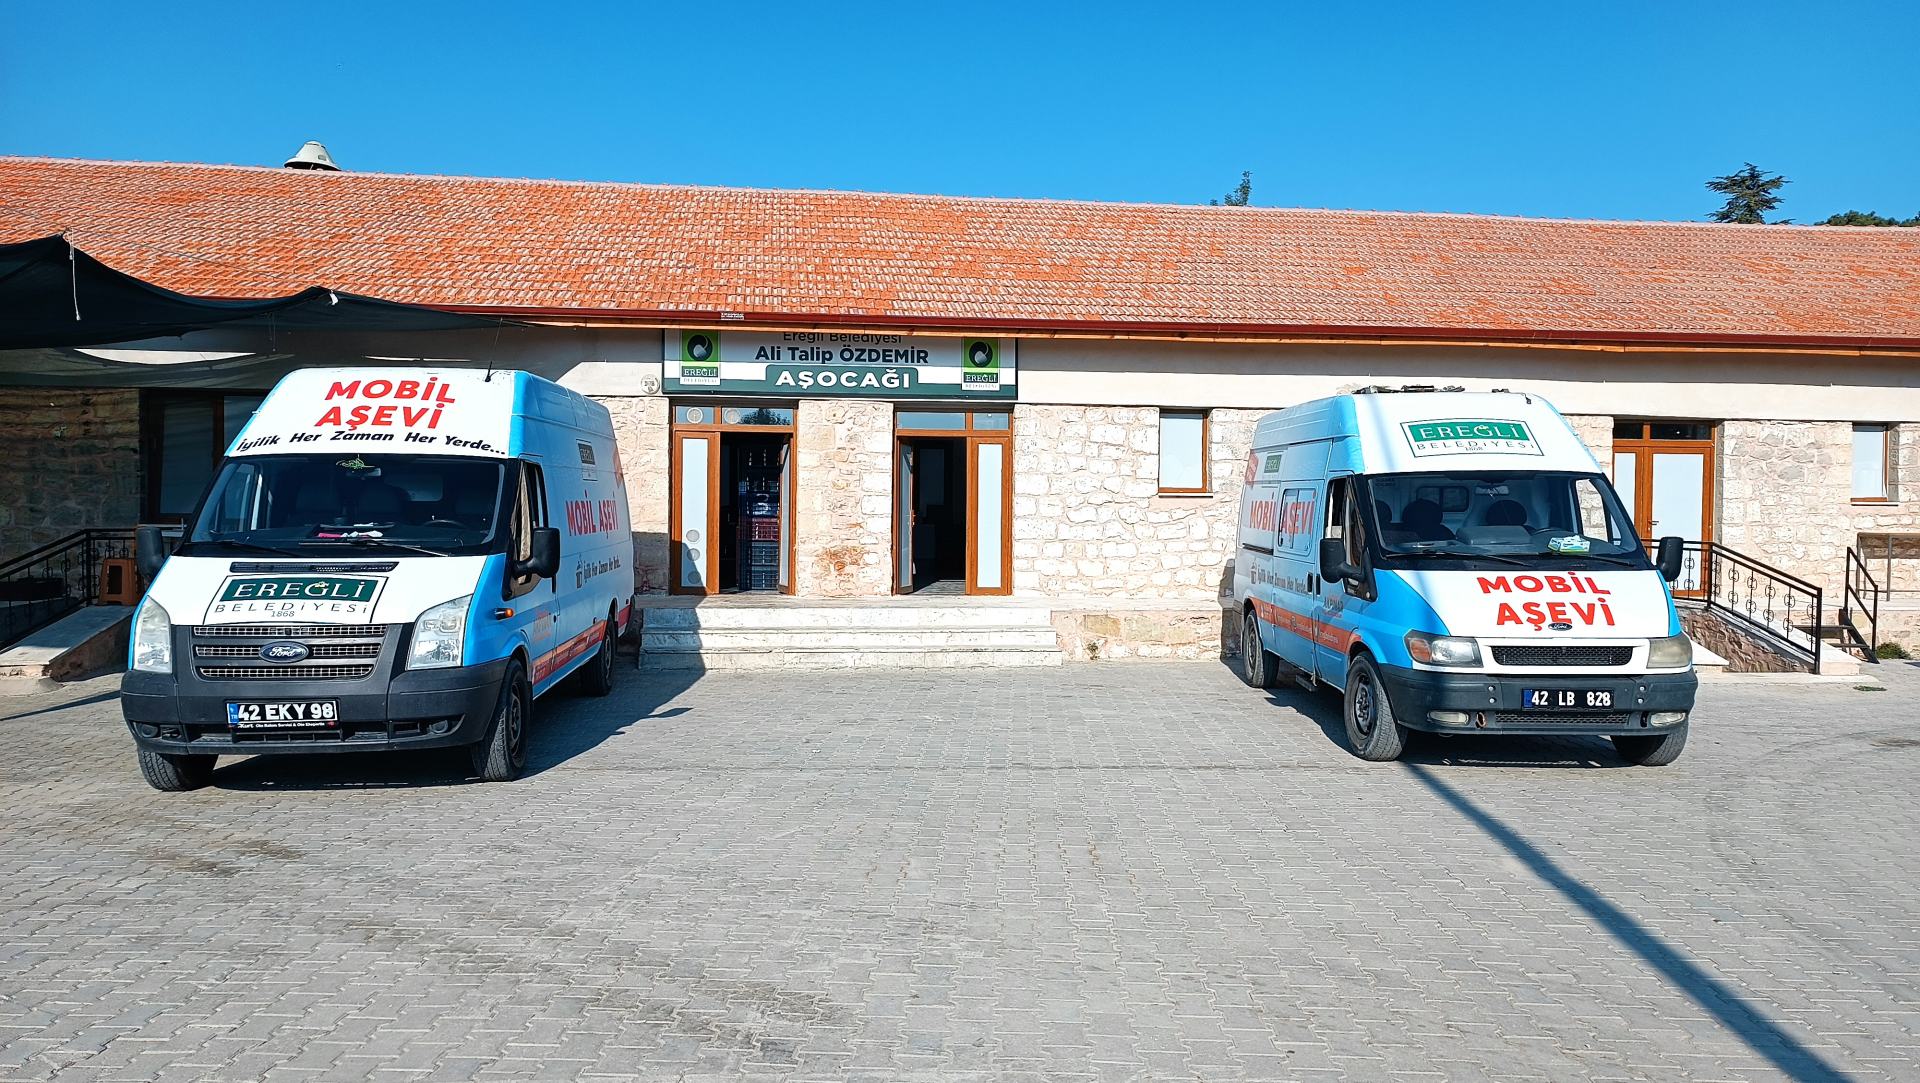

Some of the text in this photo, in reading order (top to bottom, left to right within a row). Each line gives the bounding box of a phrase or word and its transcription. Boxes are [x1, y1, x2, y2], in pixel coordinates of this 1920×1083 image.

[755, 345, 929, 364] Ali Talip ÖZDEMİR
[324, 376, 456, 404] MOBİL
[775, 368, 910, 389] AŞOCAĞI
[313, 402, 445, 431] AŞEVİ
[236, 430, 506, 455] İyilik Her Zaman Her Yerde...
[565, 489, 619, 539] MOBİL AŞEVİ
[1249, 490, 1317, 542] MOBİL AŞEVİ
[1476, 571, 1611, 595] MOBİL
[270, 610, 295, 618] 1868
[1496, 597, 1616, 631] AŞEVİ
[268, 646, 303, 658] Ford
[1532, 690, 1611, 707] 42 LB 828
[238, 704, 261, 721] 42
[265, 703, 306, 720] EKY
[310, 702, 334, 719] 98
